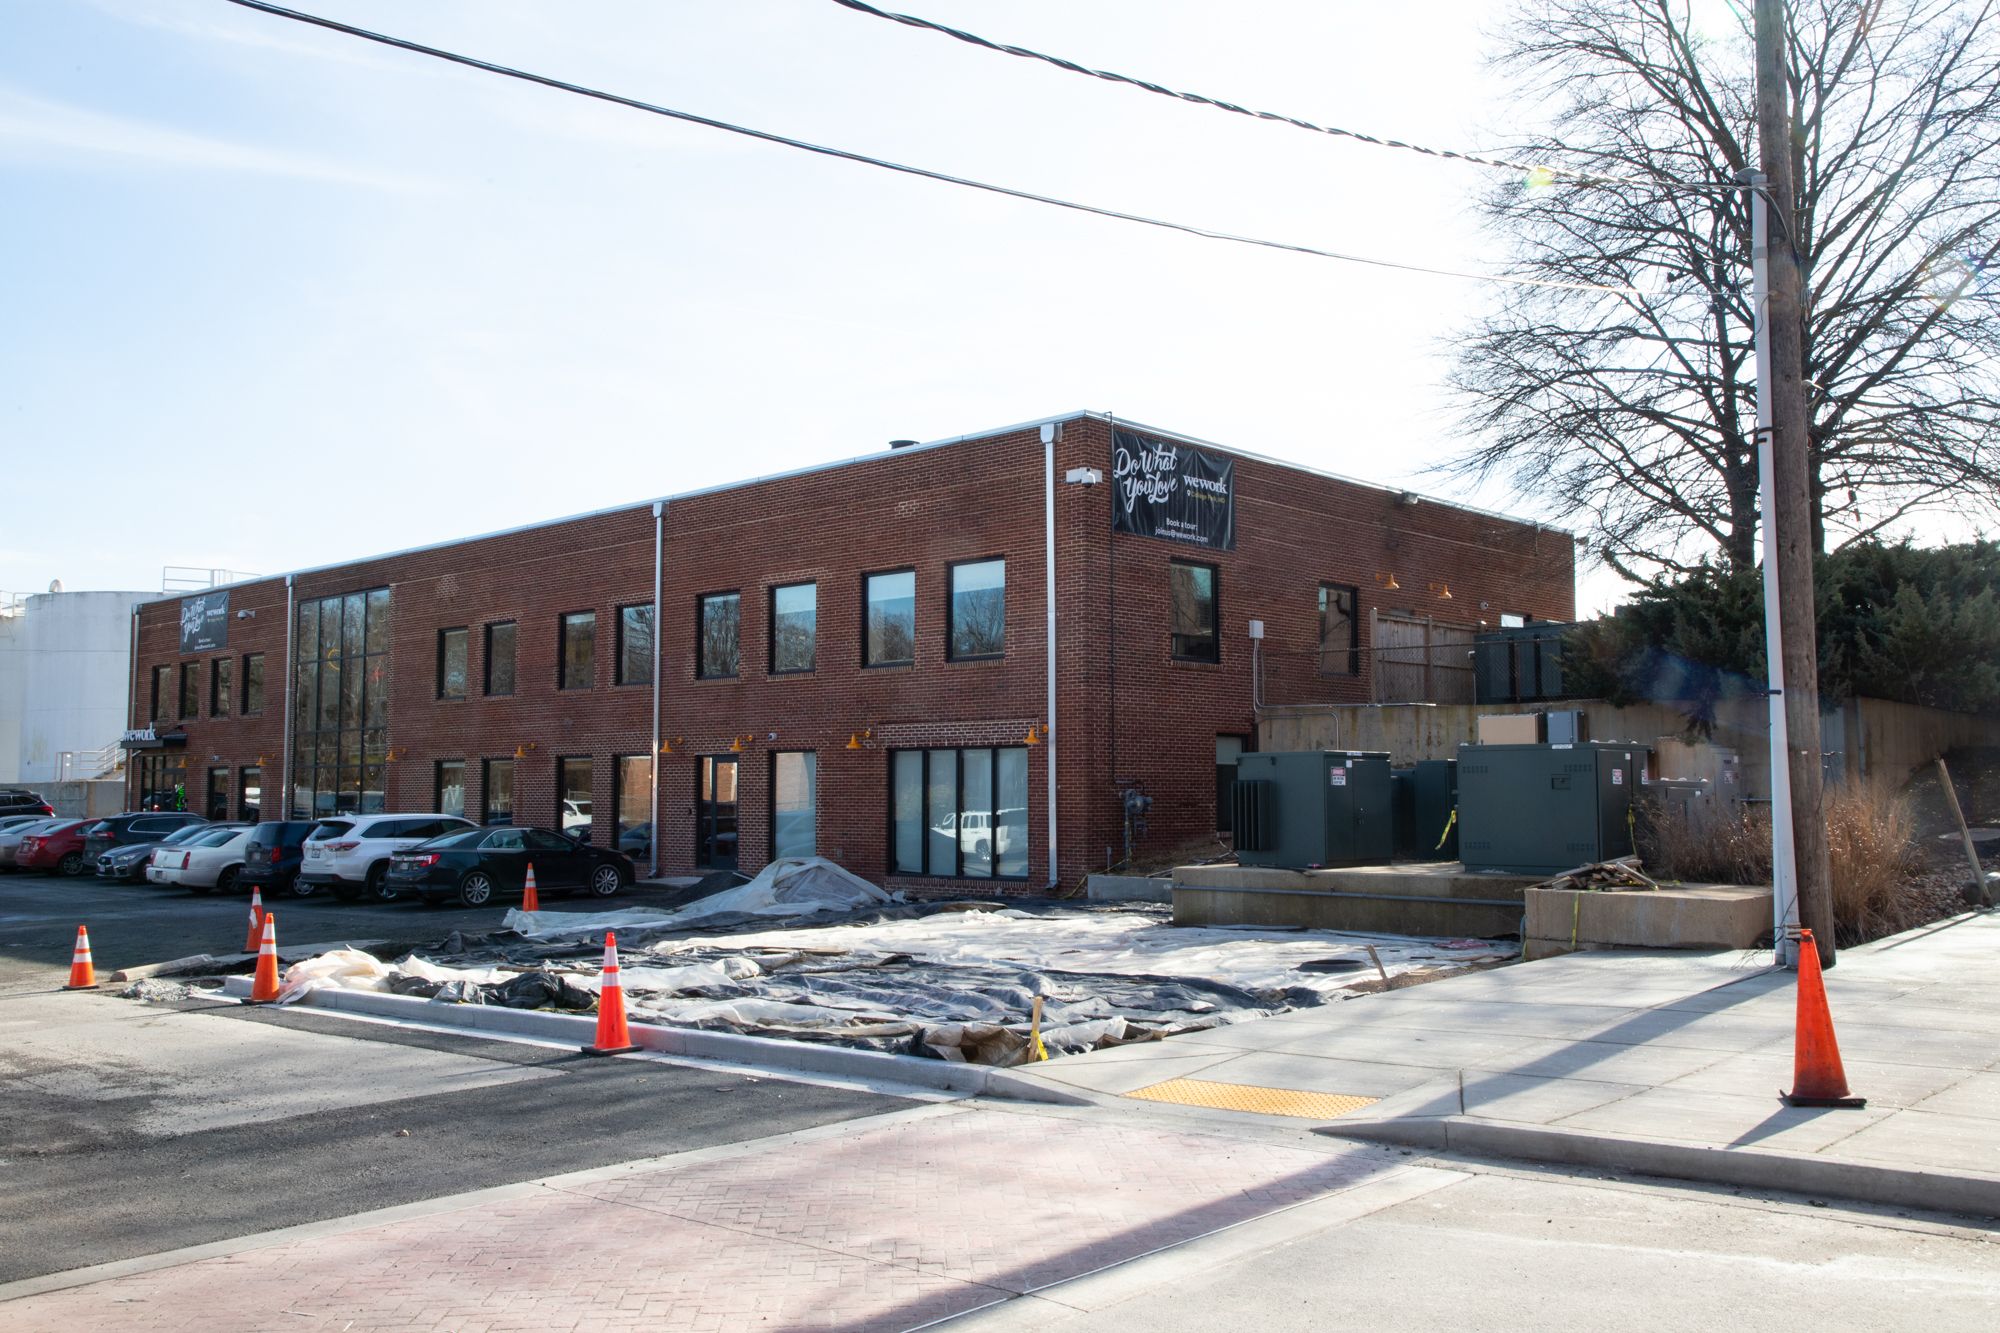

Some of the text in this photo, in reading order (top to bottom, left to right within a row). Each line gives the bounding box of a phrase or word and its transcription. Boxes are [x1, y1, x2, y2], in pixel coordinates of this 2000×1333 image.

[1113, 443, 1178, 478] Do What
[1123, 471, 1178, 513] You Love
[1183, 474, 1228, 494] wework
[1166, 517, 1180, 527] Book
[1155, 526, 1209, 543] joinus@wework.com
[123, 721, 156, 741] wework
